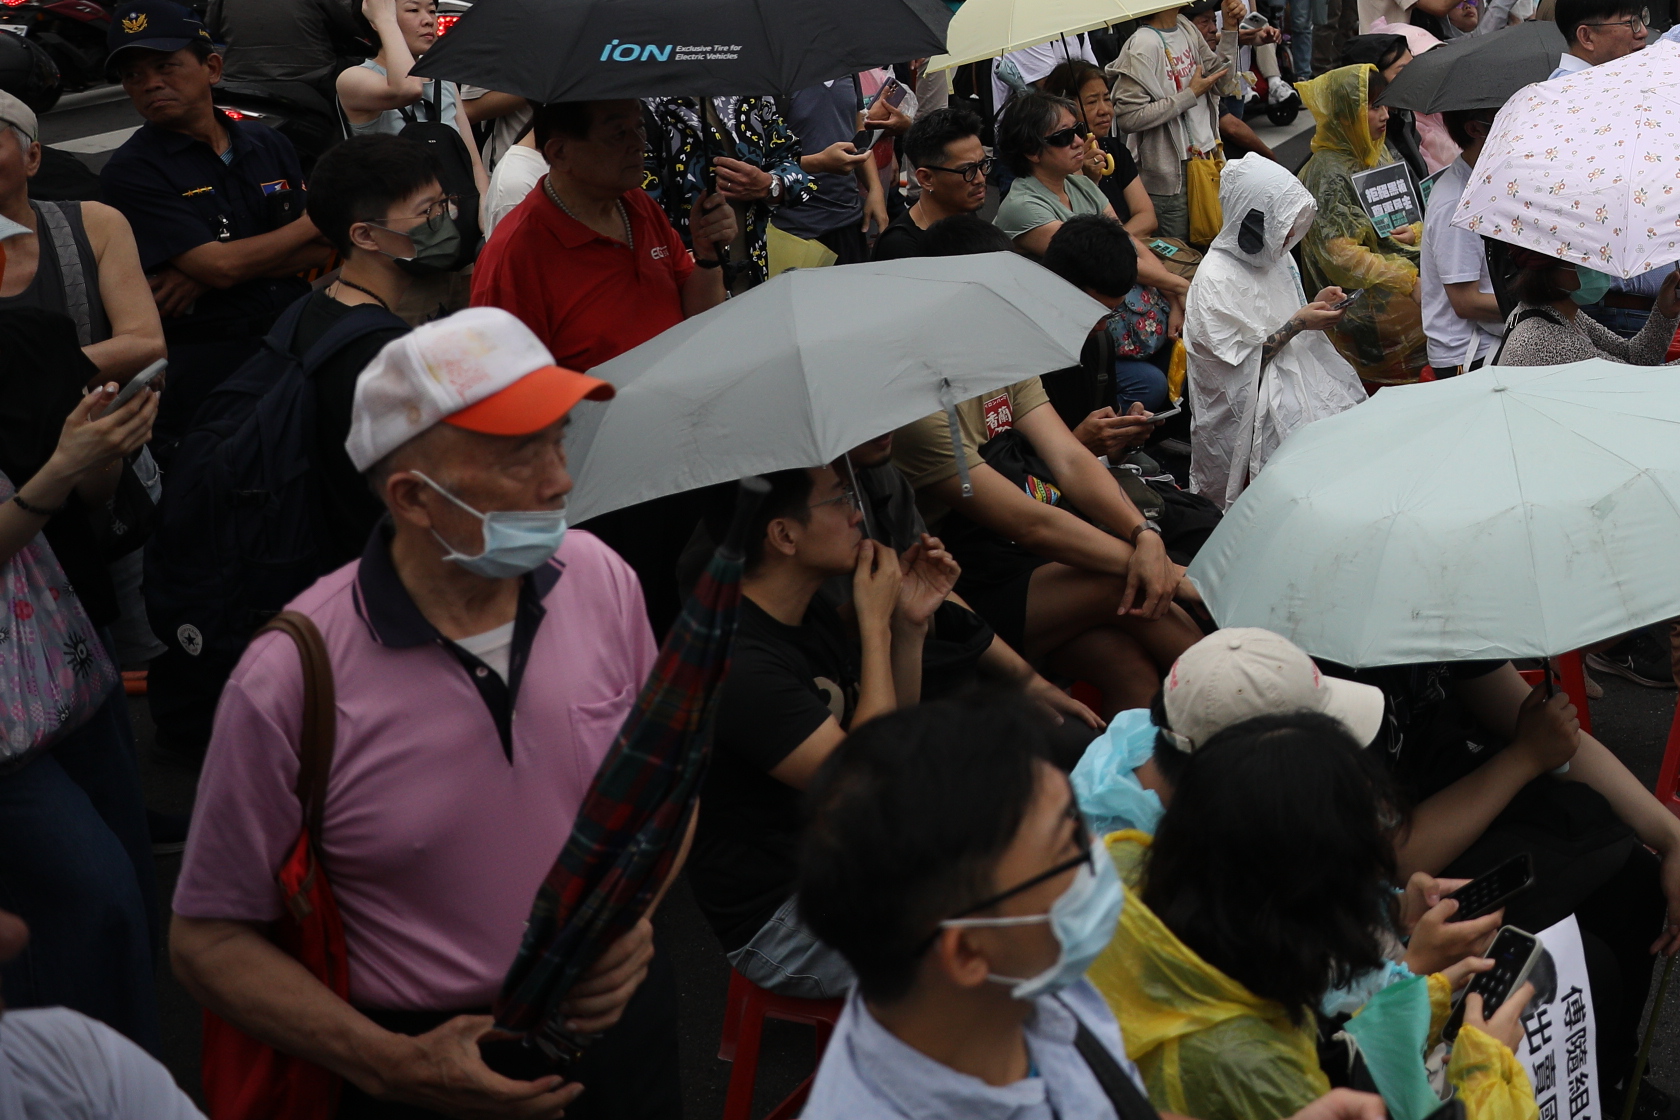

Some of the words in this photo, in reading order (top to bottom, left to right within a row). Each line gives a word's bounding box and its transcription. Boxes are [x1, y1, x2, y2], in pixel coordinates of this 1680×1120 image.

[600, 39, 673, 62] iON
[713, 44, 729, 52] Tire
[675, 53, 705, 61] Electric
[706, 52, 738, 60] Vehicles
[986, 405, 1012, 429] 香蘭
